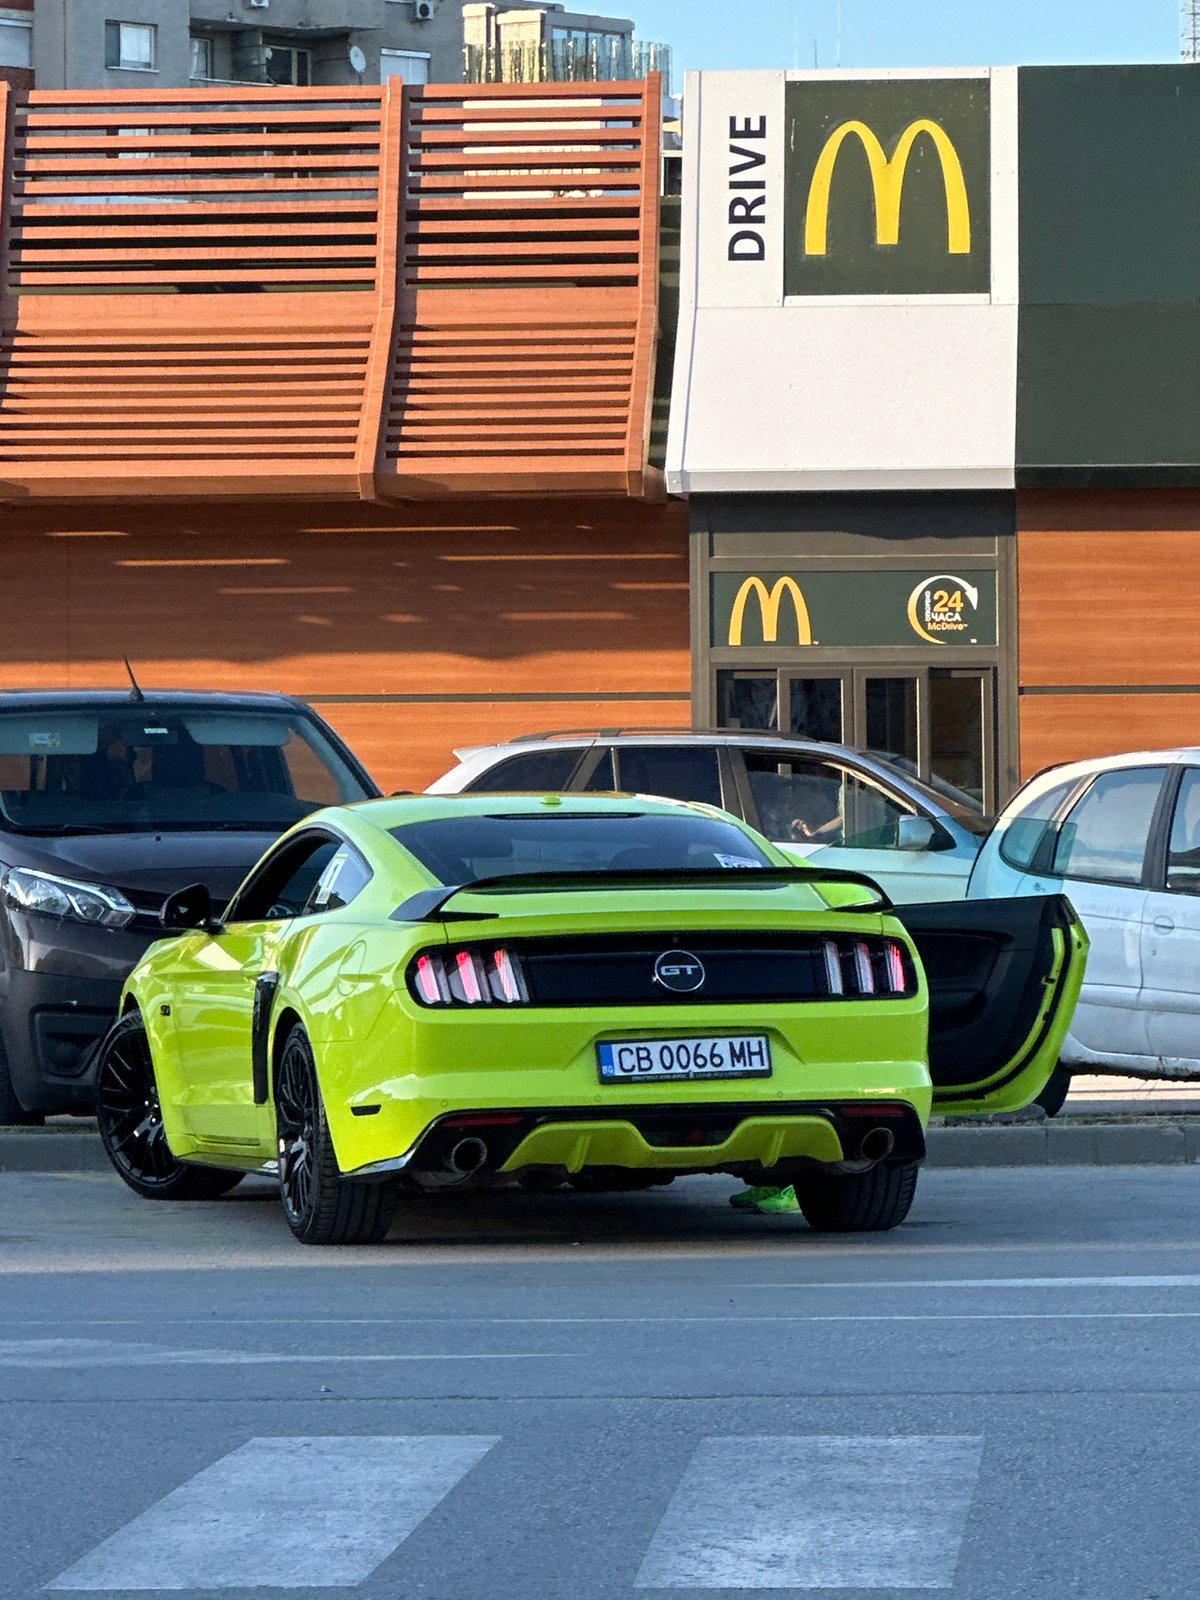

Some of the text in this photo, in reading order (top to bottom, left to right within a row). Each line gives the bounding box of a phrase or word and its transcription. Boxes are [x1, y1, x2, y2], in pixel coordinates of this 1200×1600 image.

[727, 114, 766, 261] DRIVE
[933, 589, 964, 613] 24
[931, 612, 962, 622] ЧАСА
[660, 964, 699, 976] GT
[659, 1042, 724, 1071] 0066
